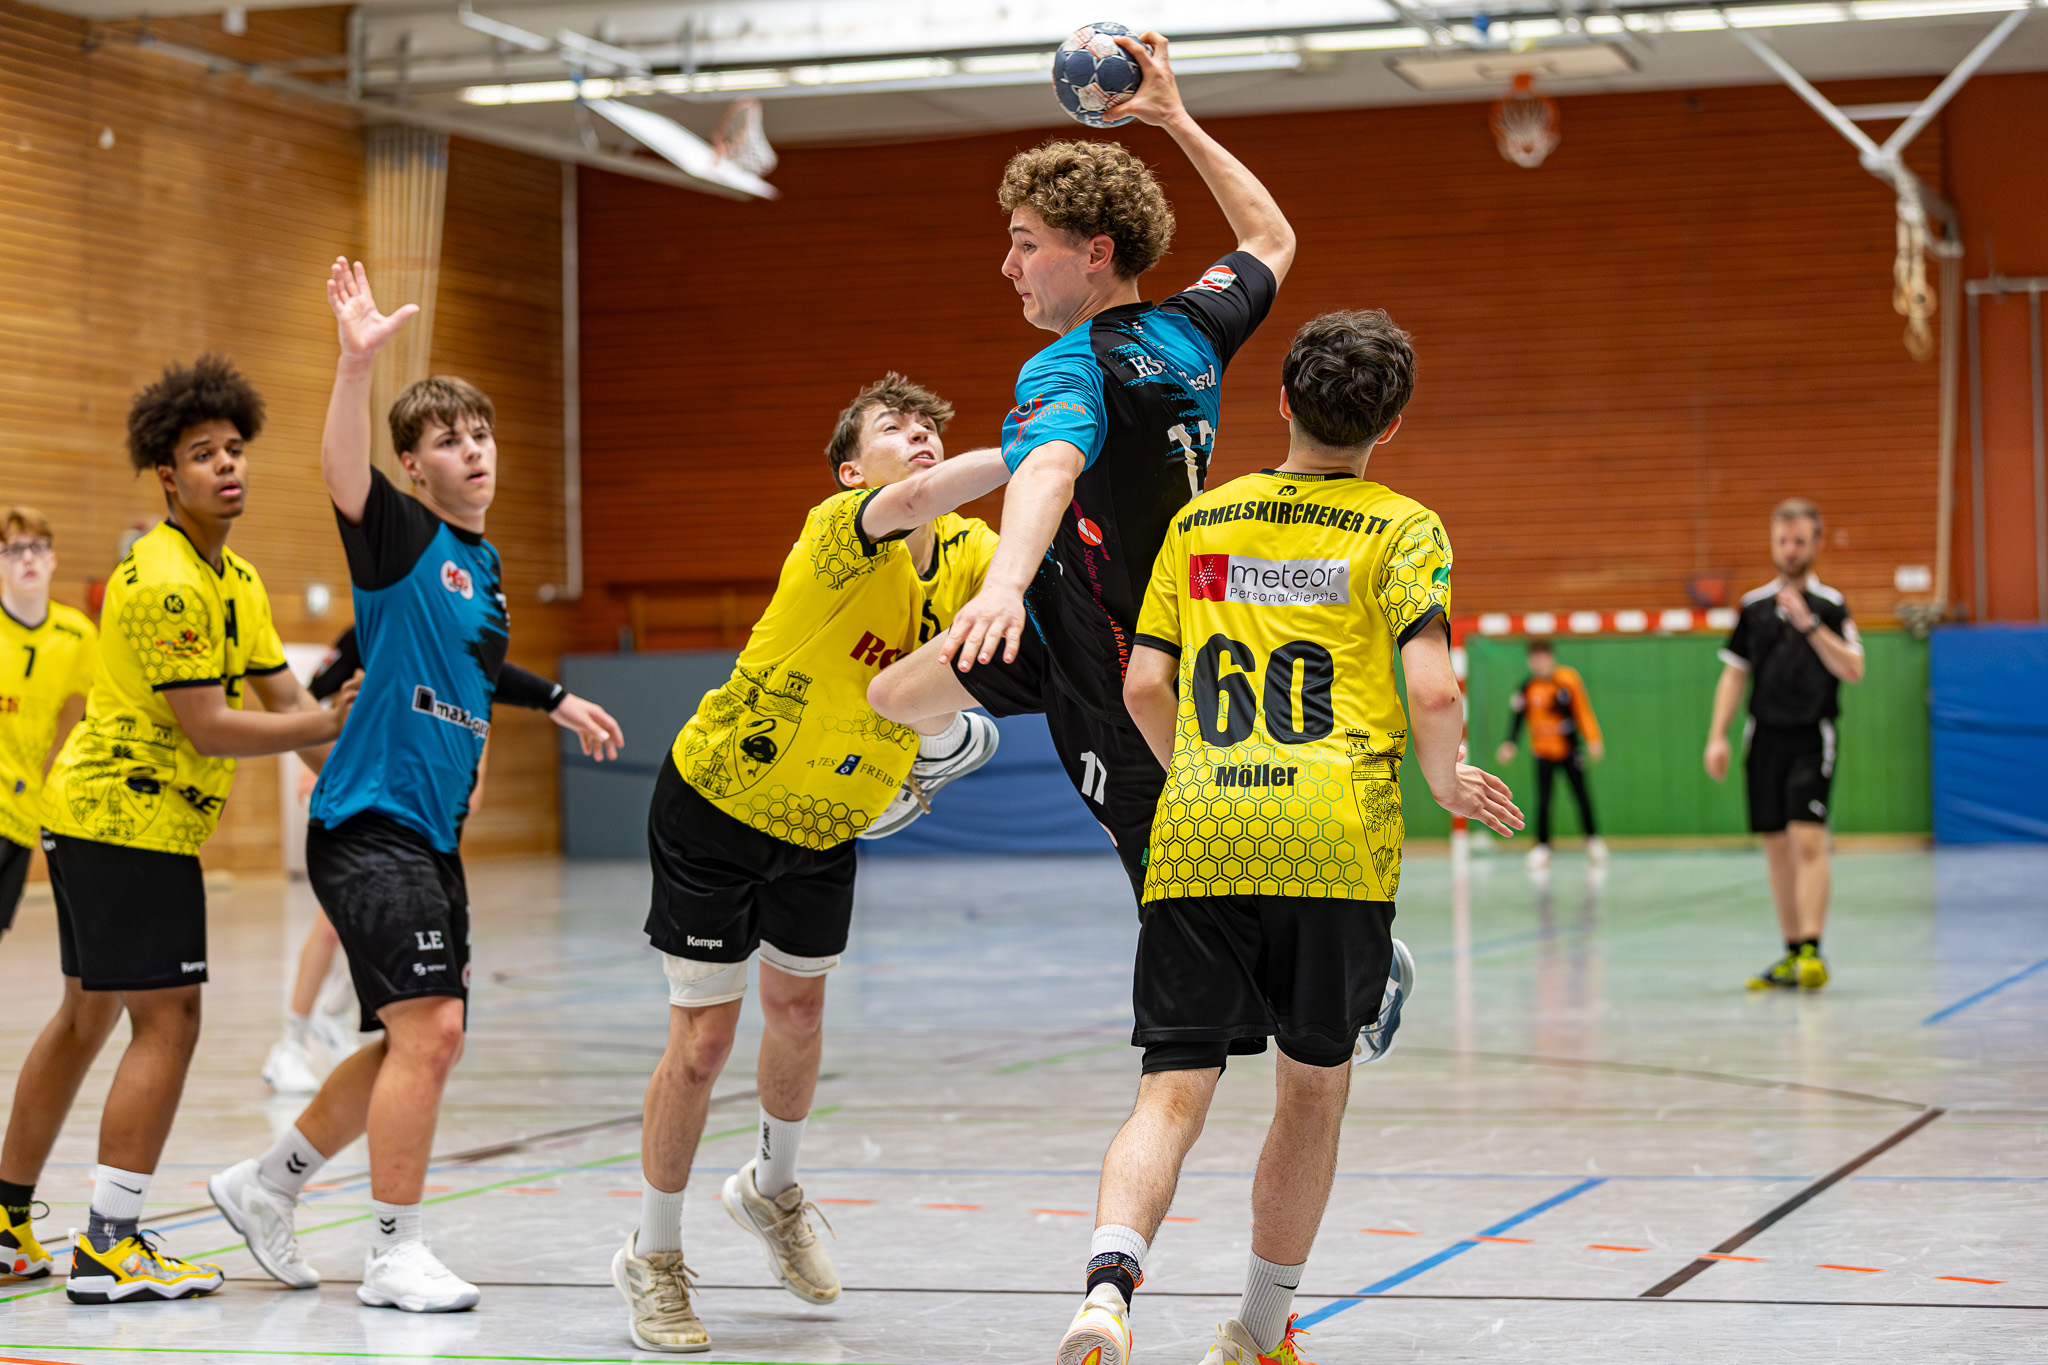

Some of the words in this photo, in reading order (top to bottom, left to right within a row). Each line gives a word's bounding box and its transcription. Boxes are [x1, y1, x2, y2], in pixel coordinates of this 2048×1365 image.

[1083, 547, 1099, 579] Stefan
[1229, 587, 1338, 603] Personaldienste
[23, 645, 36, 678] 7
[1193, 633, 1335, 747] 60
[1215, 763, 1299, 788] Möller
[414, 930, 445, 952] LE
[687, 934, 723, 950] Kempa
